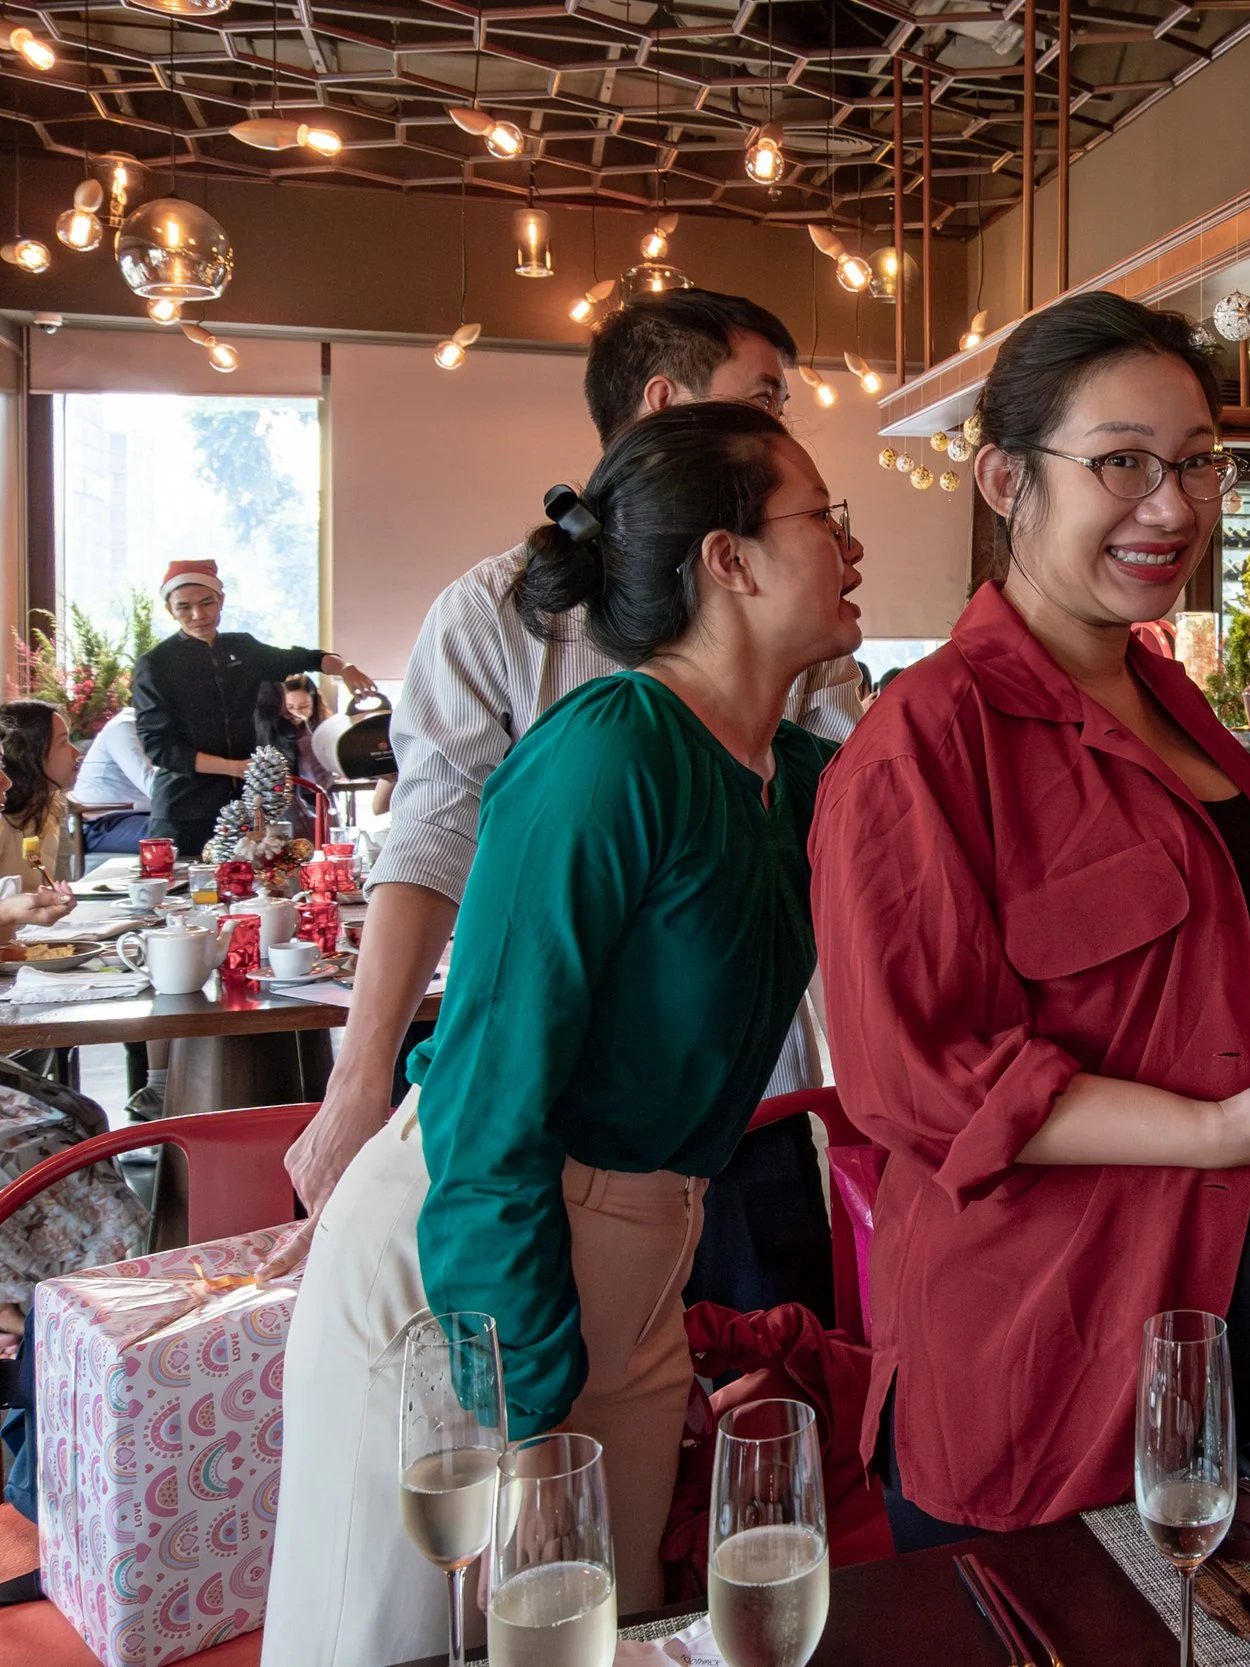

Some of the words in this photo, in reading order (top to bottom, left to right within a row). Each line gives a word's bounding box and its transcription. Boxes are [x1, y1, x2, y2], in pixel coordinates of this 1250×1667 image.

[230, 1331, 241, 1363] LOVE
[133, 1501, 143, 1528] LOVE
[240, 1511, 250, 1541] LOVE
